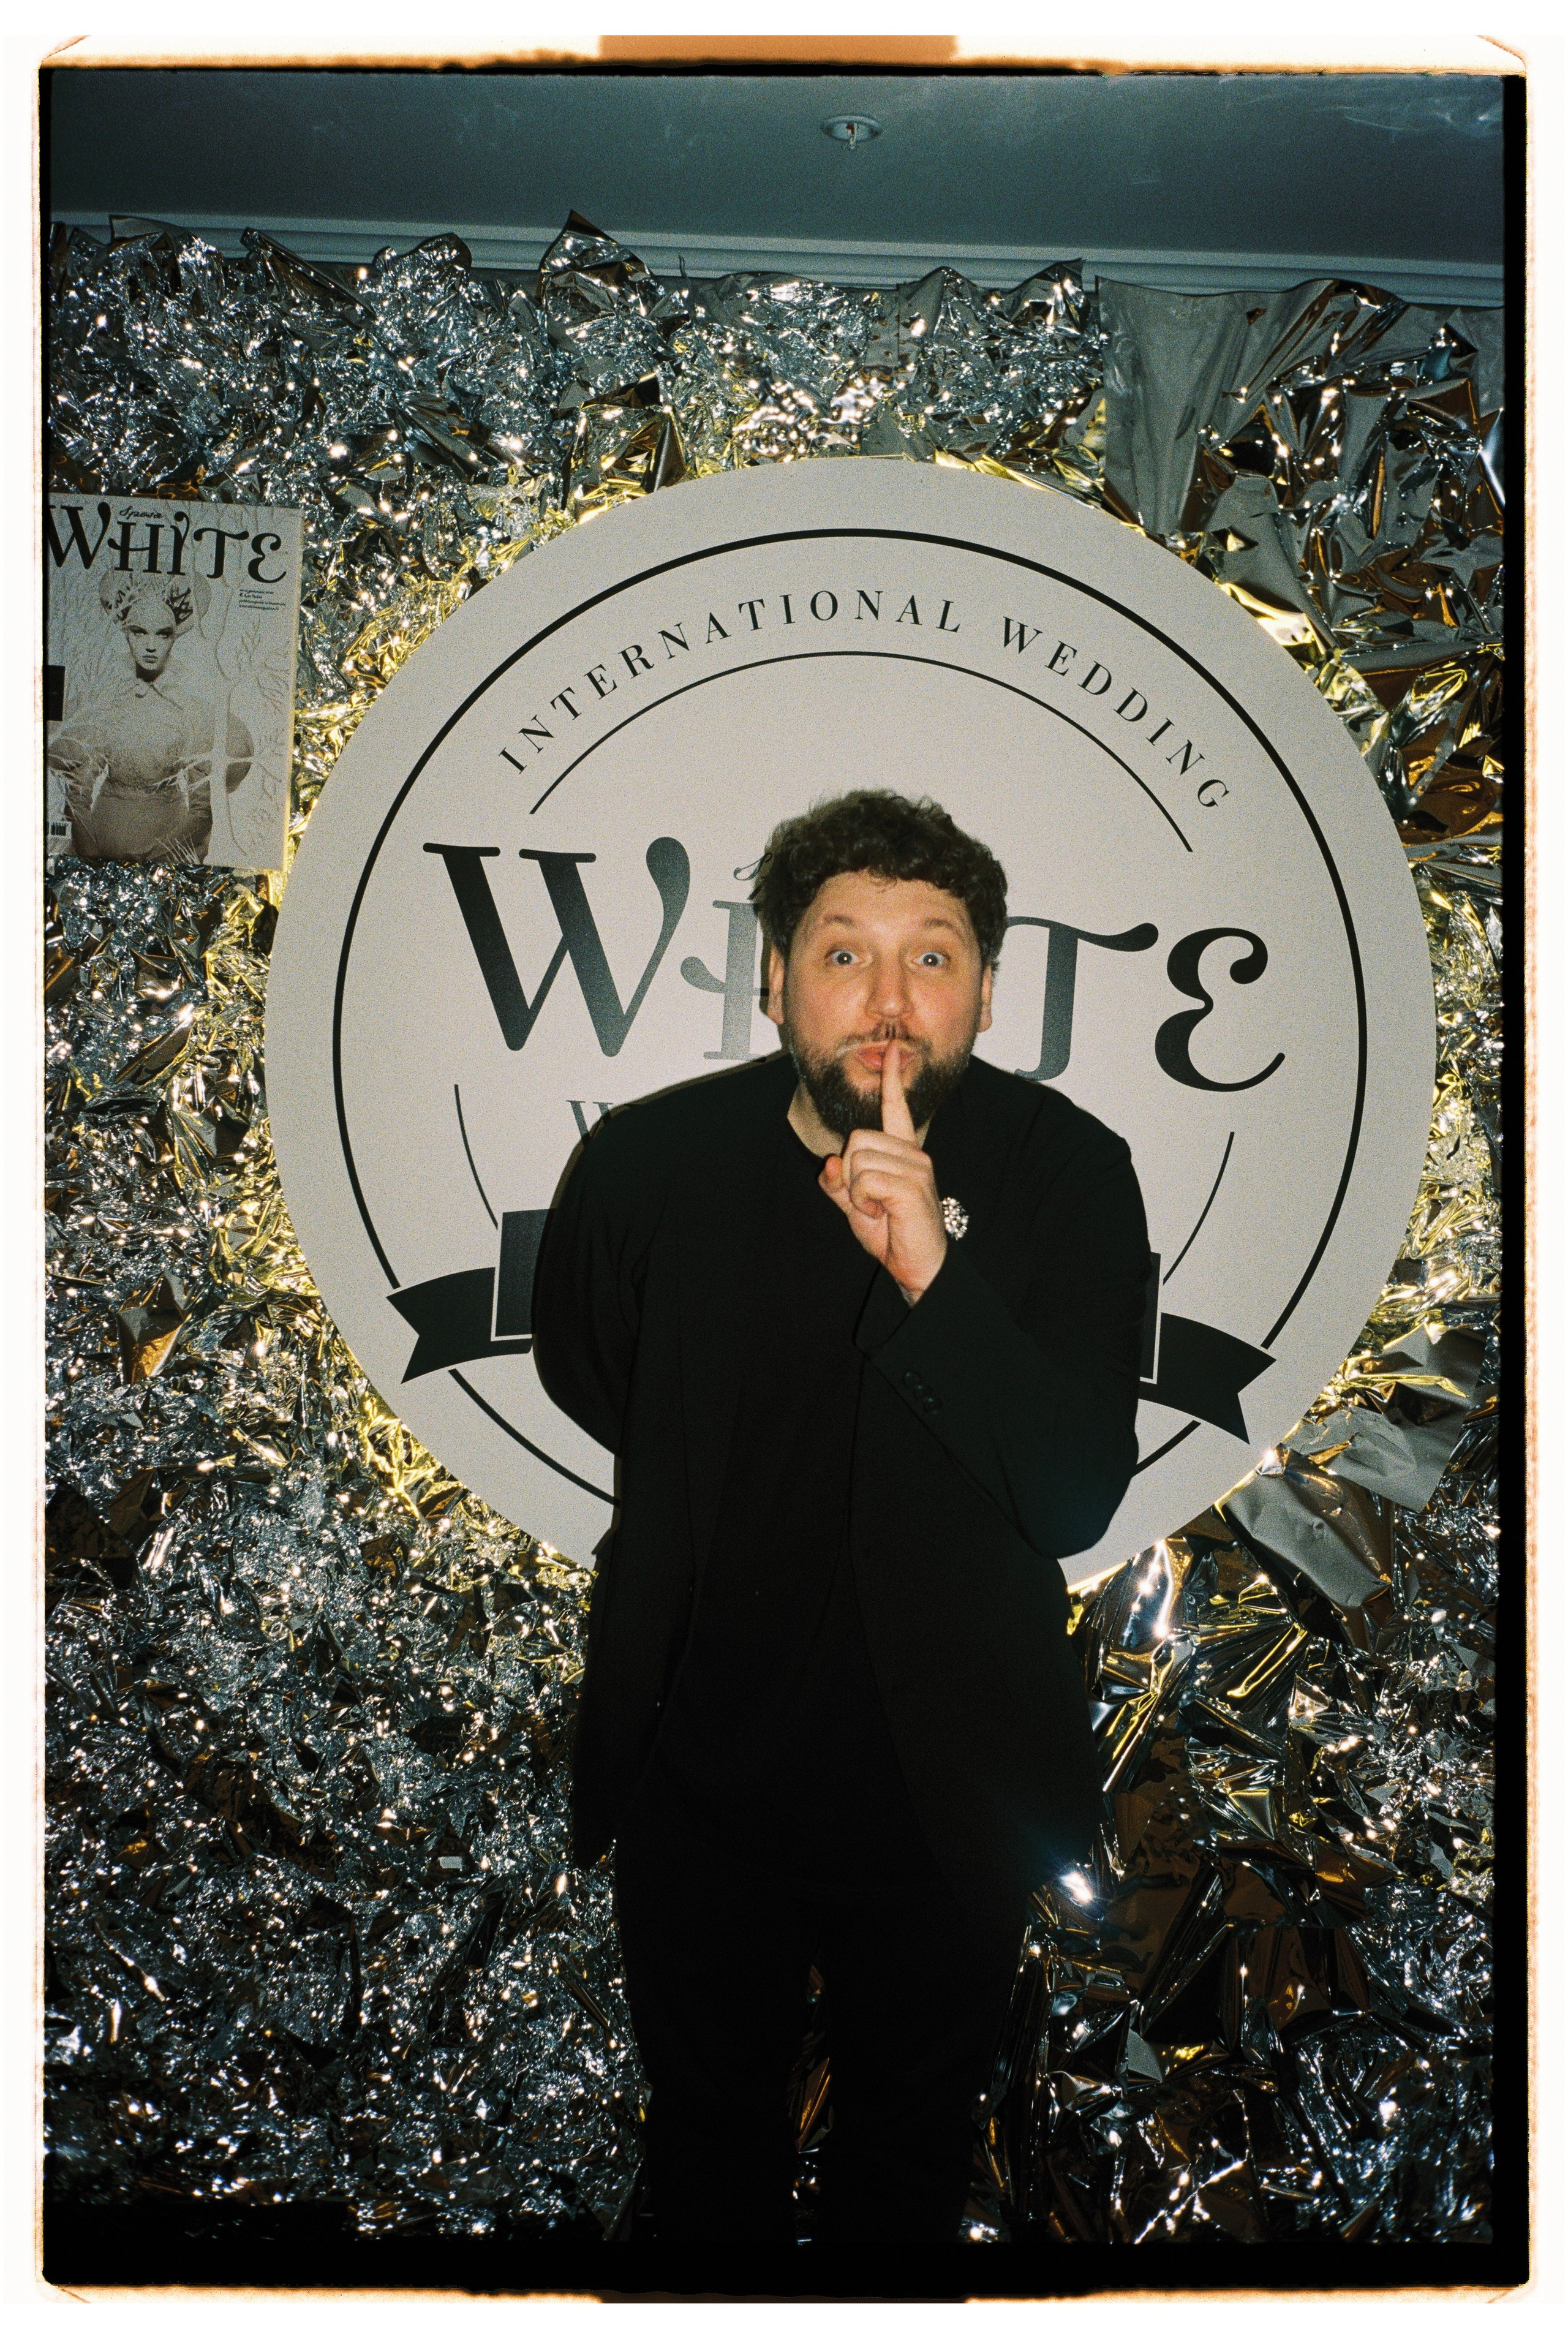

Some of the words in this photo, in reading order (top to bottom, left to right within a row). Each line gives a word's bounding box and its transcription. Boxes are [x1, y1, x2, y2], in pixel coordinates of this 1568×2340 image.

[47, 502, 287, 583] WHITE
[498, 589, 961, 774] INTERNATIONAL
[1002, 616, 1230, 810] WEDDING
